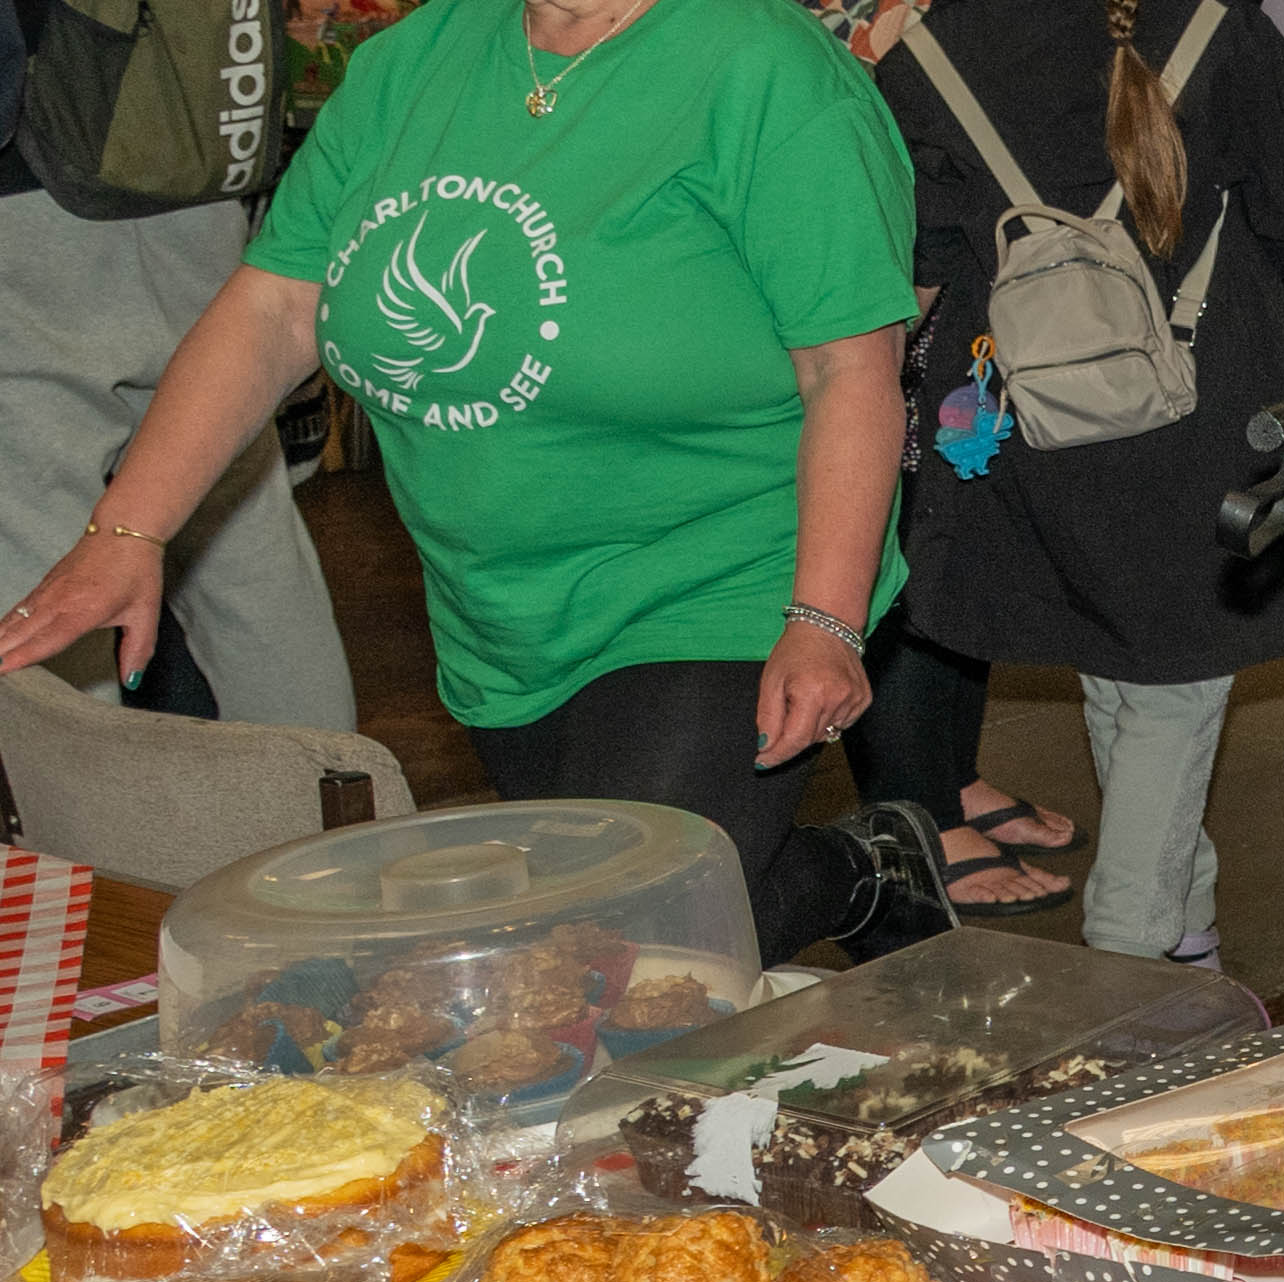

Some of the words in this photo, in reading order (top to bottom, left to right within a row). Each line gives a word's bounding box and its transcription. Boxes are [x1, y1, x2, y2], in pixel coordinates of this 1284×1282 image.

[324, 341, 412, 416] COME
[424, 401, 499, 431] AND
[500, 354, 552, 412] SEE
